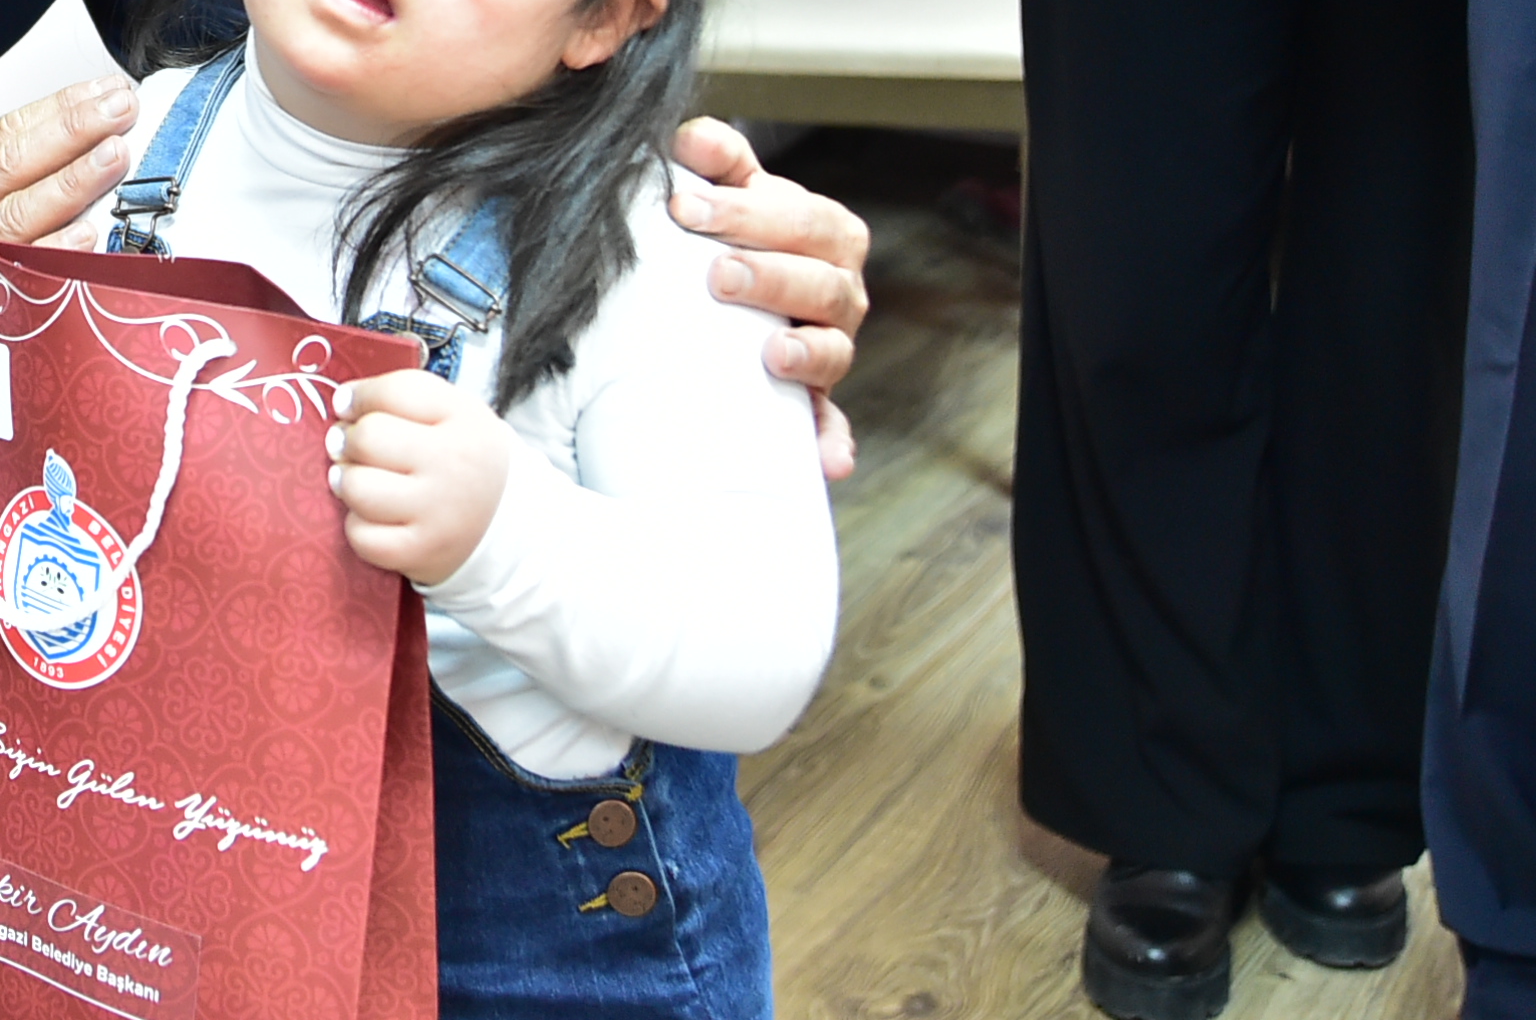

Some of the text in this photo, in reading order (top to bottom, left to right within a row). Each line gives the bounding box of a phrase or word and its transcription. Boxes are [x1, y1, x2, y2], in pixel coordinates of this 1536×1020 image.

[87, 519, 136, 668] BELDİYESİ
[32, 656, 64, 679] 1893
[56, 758, 165, 810] Gülen
[172, 792, 329, 873] Yüzümüz
[47, 898, 173, 967] Aydın
[31, 934, 93, 977] Belediye
[96, 964, 160, 1004] Başkanı
